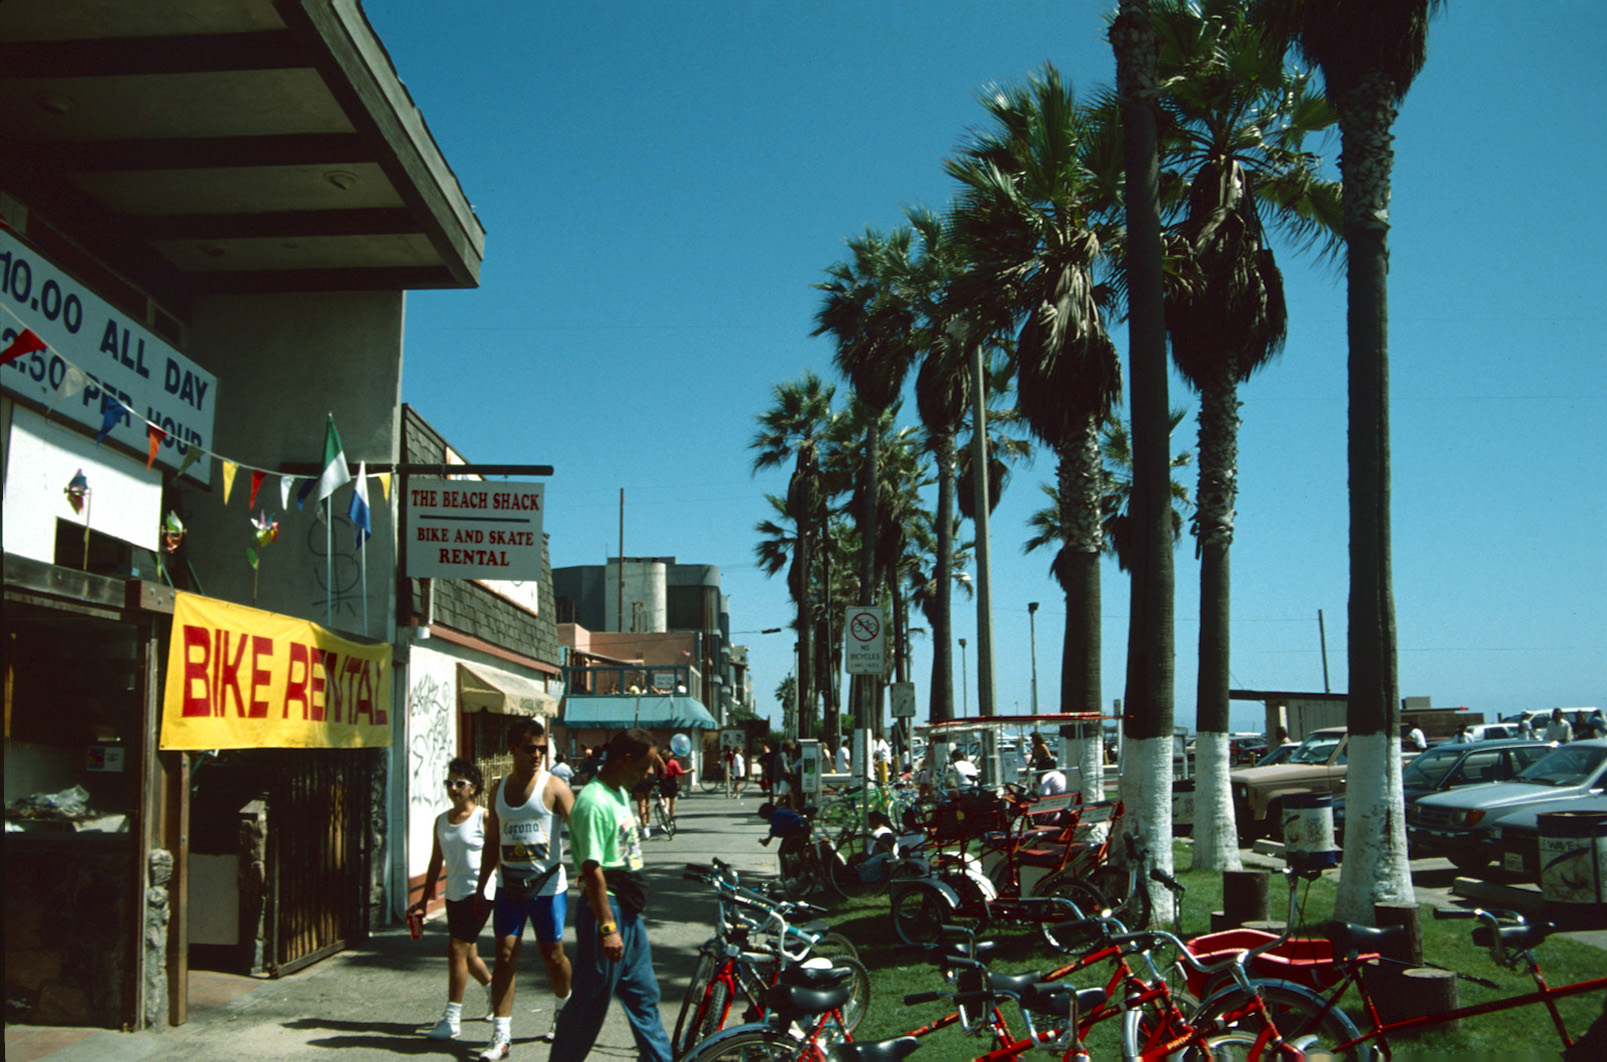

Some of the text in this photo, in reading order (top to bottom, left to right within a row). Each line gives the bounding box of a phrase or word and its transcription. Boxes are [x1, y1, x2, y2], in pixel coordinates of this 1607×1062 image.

[100, 319, 150, 380] ALL
[164, 357, 208, 411] DAY
[411, 490, 540, 511] THE BEACH SHACK
[417, 527, 534, 546] BIKE AND SKATE
[439, 548, 510, 567] RENTAL
[182, 624, 388, 725] BIKE RENTAL
[503, 822, 539, 834] Corona
